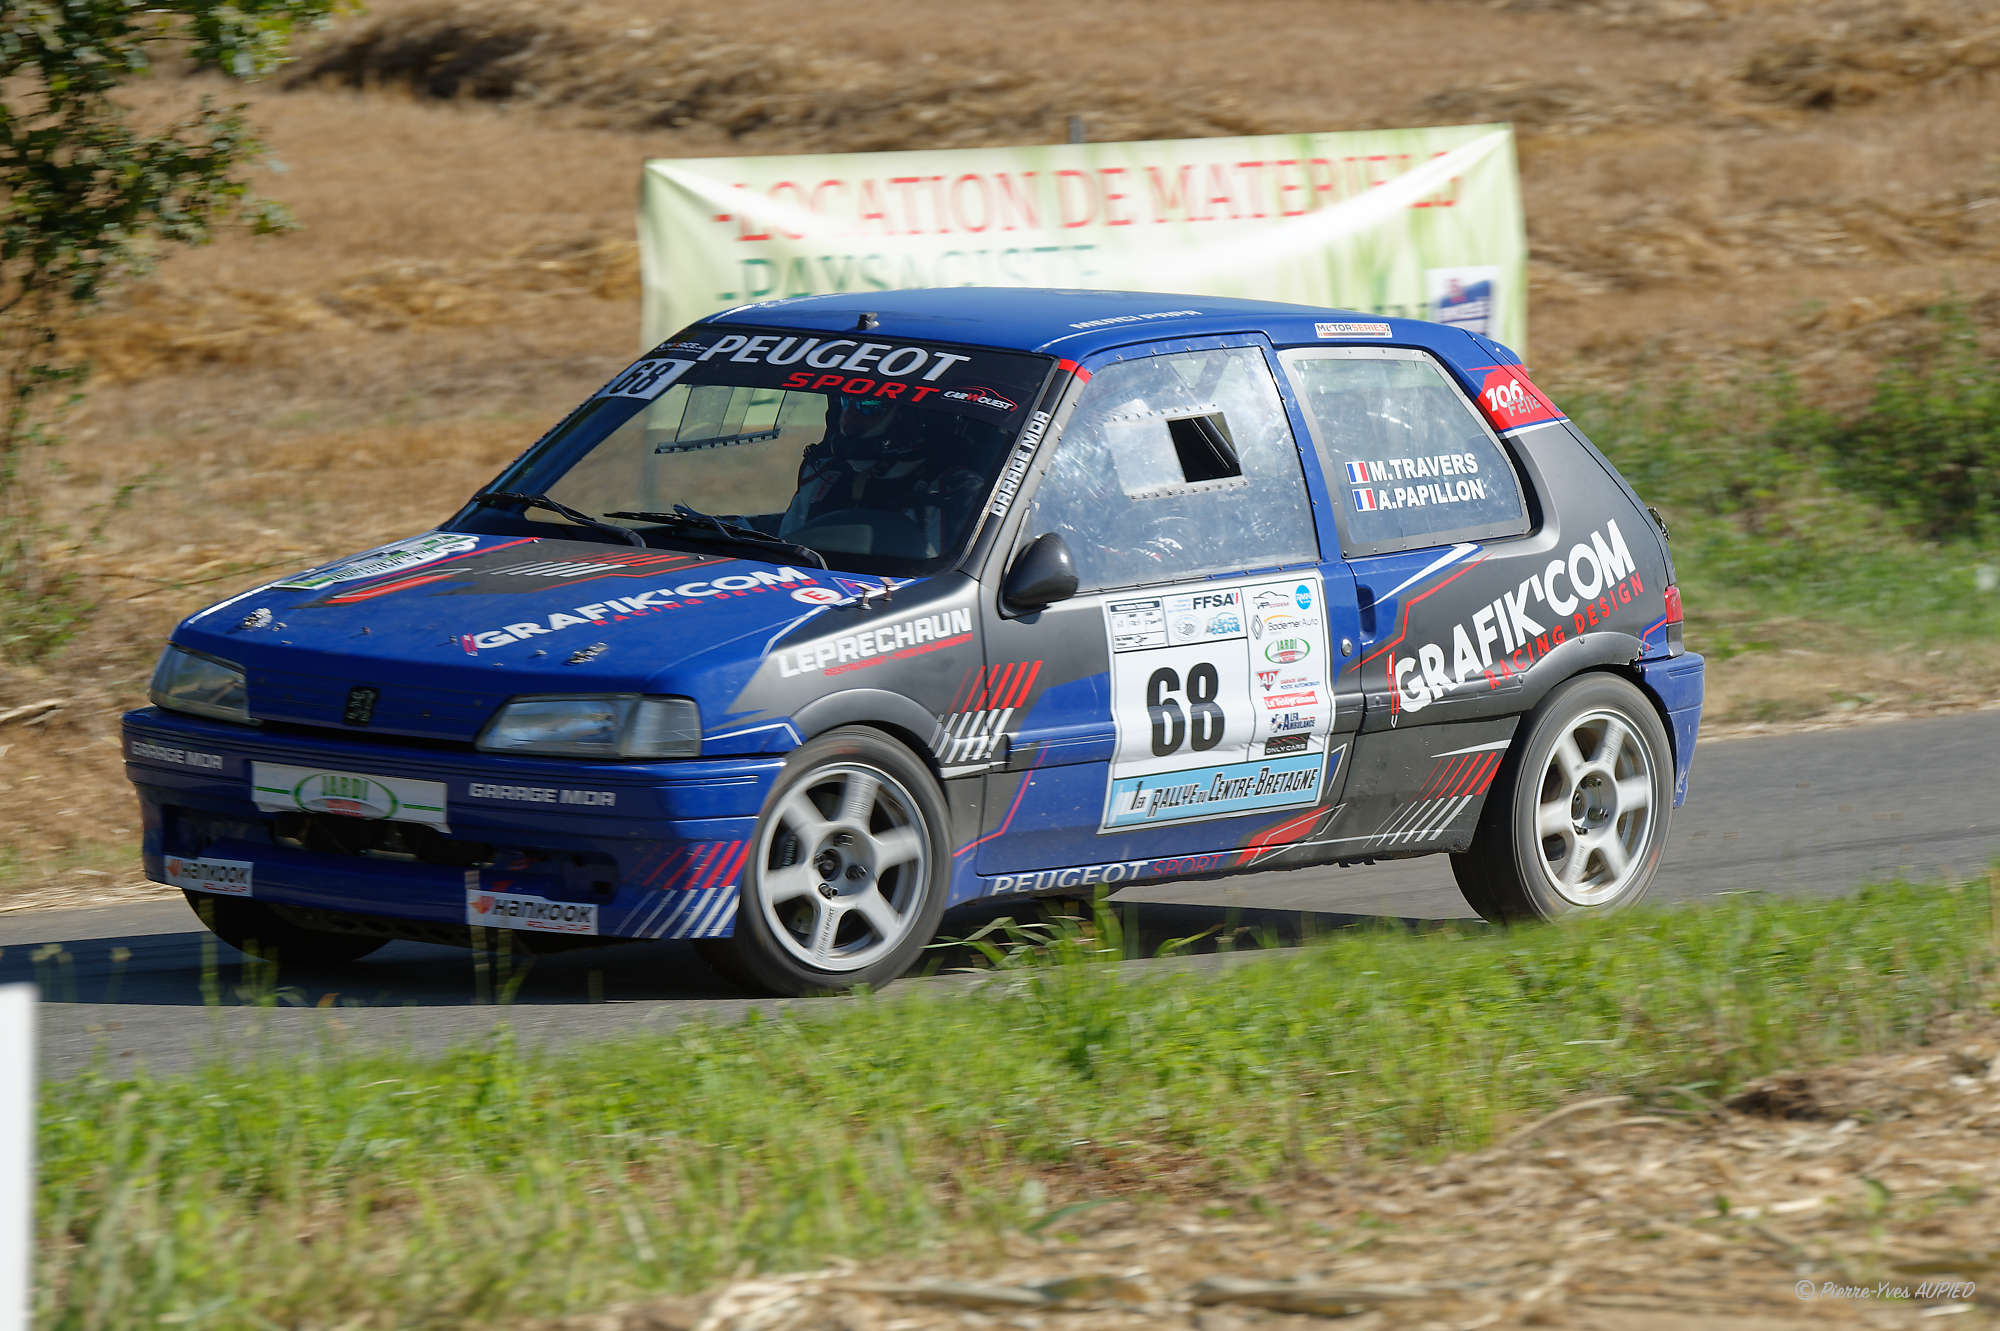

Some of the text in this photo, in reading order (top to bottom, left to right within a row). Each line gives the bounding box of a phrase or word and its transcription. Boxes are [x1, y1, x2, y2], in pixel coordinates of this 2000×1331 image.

[1056, 167, 1137, 229] DE
[608, 359, 677, 395] 68
[697, 335, 971, 381] PEUGEOT
[781, 372, 940, 402] SPORT
[1485, 378, 1524, 412] 106
[990, 449, 1033, 518] GARAGE
[1368, 453, 1478, 481] M.TRAVERS
[1379, 478, 1486, 510] A.PAPILLON
[473, 566, 810, 649] GRAFIK'COM
[591, 578, 820, 626] RACING DESIGN
[1395, 518, 1636, 713] GRAFIK'COM
[776, 608, 973, 678] LEPRECHAUN
[1483, 572, 1645, 690] RACING DESIGN
[1146, 661, 1226, 758] 68
[131, 741, 186, 764] GARAGE
[1266, 746, 1285, 754] ONLY
[469, 783, 558, 804] GARAGE
[990, 853, 1226, 896] PEUGEOT SPORT
